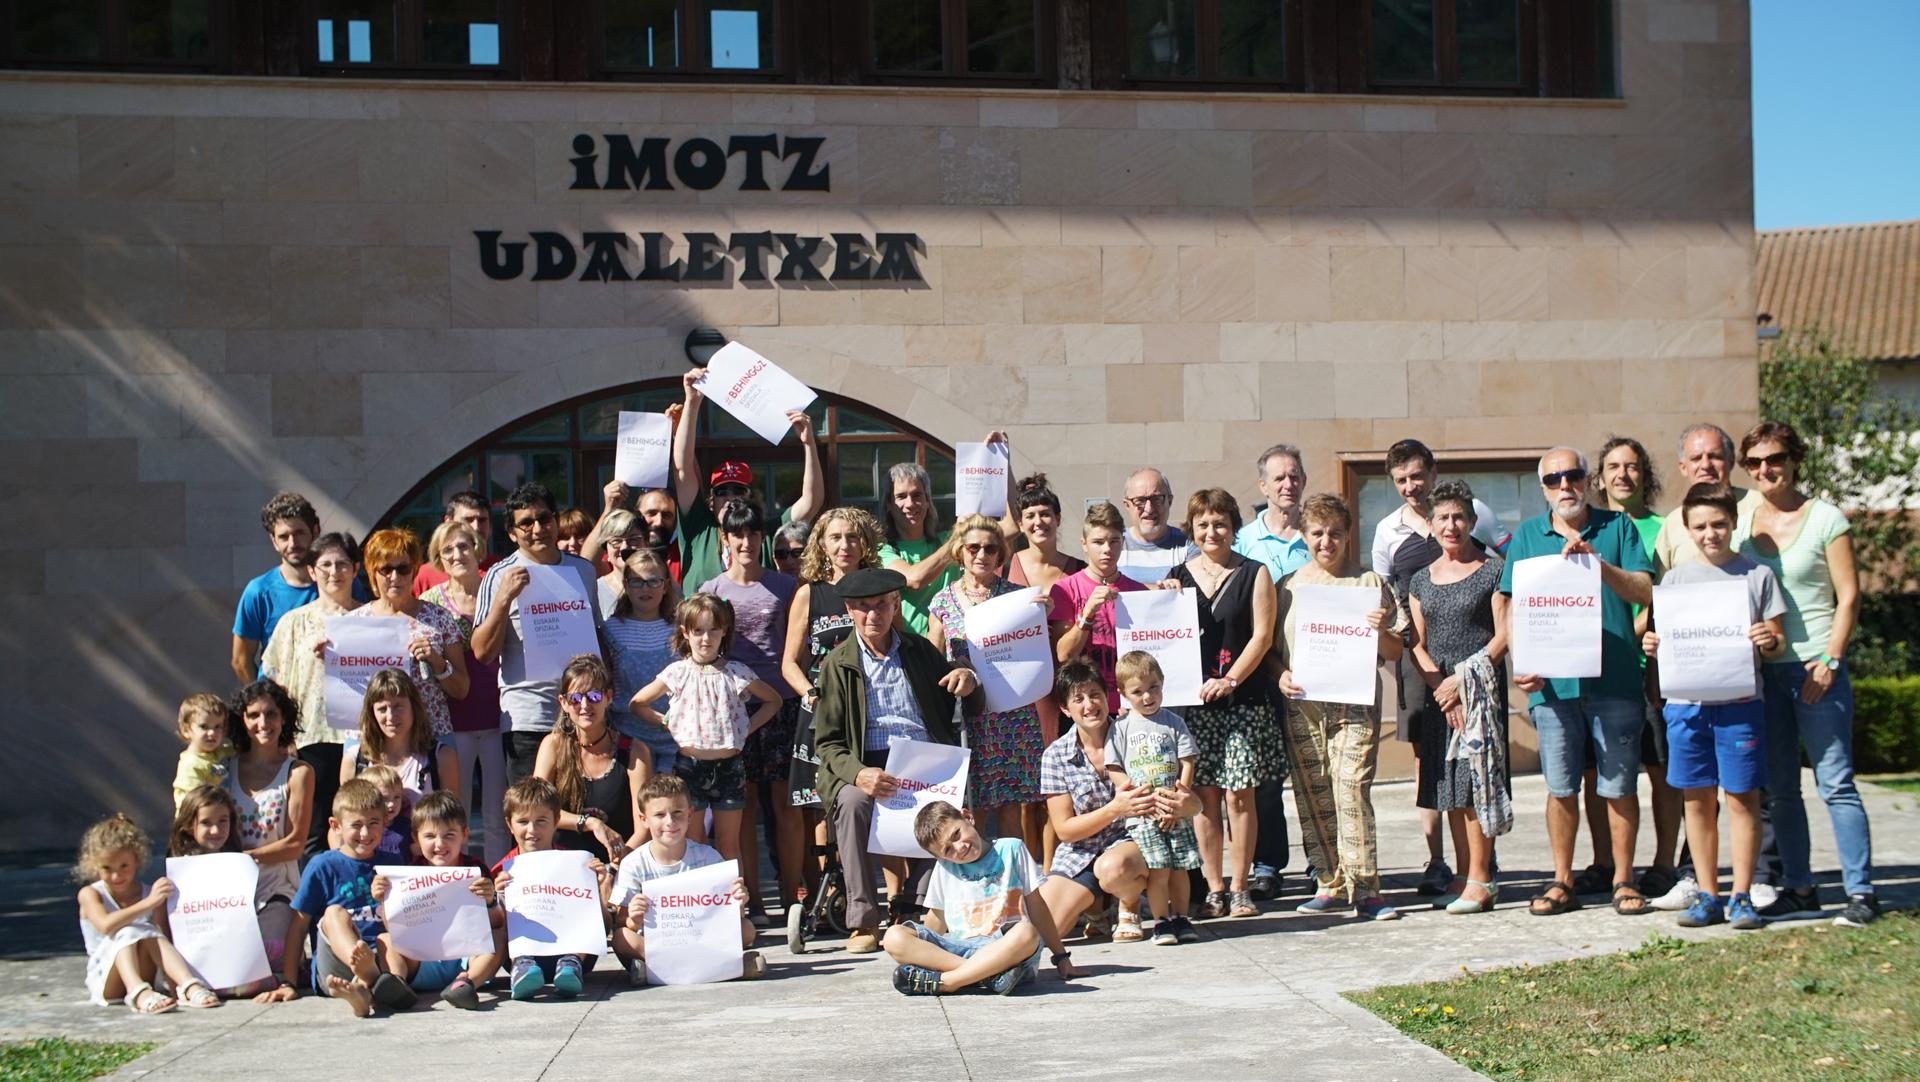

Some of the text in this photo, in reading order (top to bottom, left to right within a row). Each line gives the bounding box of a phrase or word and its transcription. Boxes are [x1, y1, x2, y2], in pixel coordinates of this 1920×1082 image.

[473, 230, 924, 284] UDALETXEA
[661, 912, 696, 920] EUSKARA
[661, 921, 694, 929] OFIZIALA
